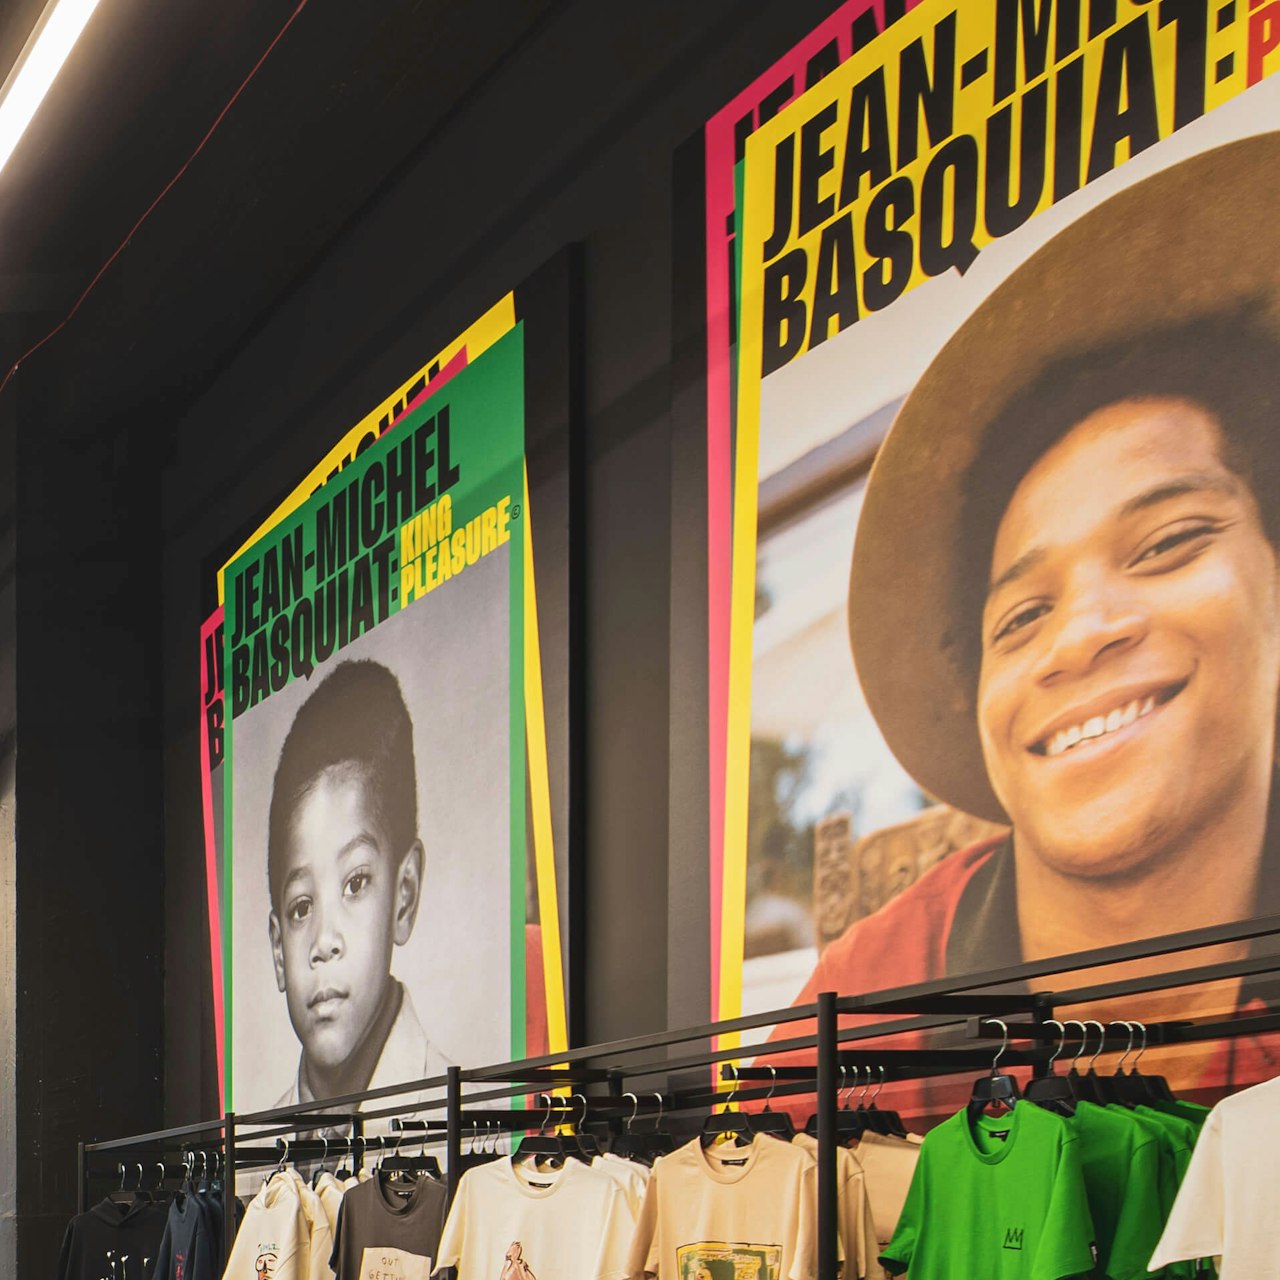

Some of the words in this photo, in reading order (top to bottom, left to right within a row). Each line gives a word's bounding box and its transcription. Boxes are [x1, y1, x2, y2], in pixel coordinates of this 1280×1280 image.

[762, 0, 1236, 379] BASQUIAT:
[232, 404, 461, 648] JEAN-MICHEL
[232, 540, 399, 721] BASQUIAT:
[400, 494, 452, 567] KING
